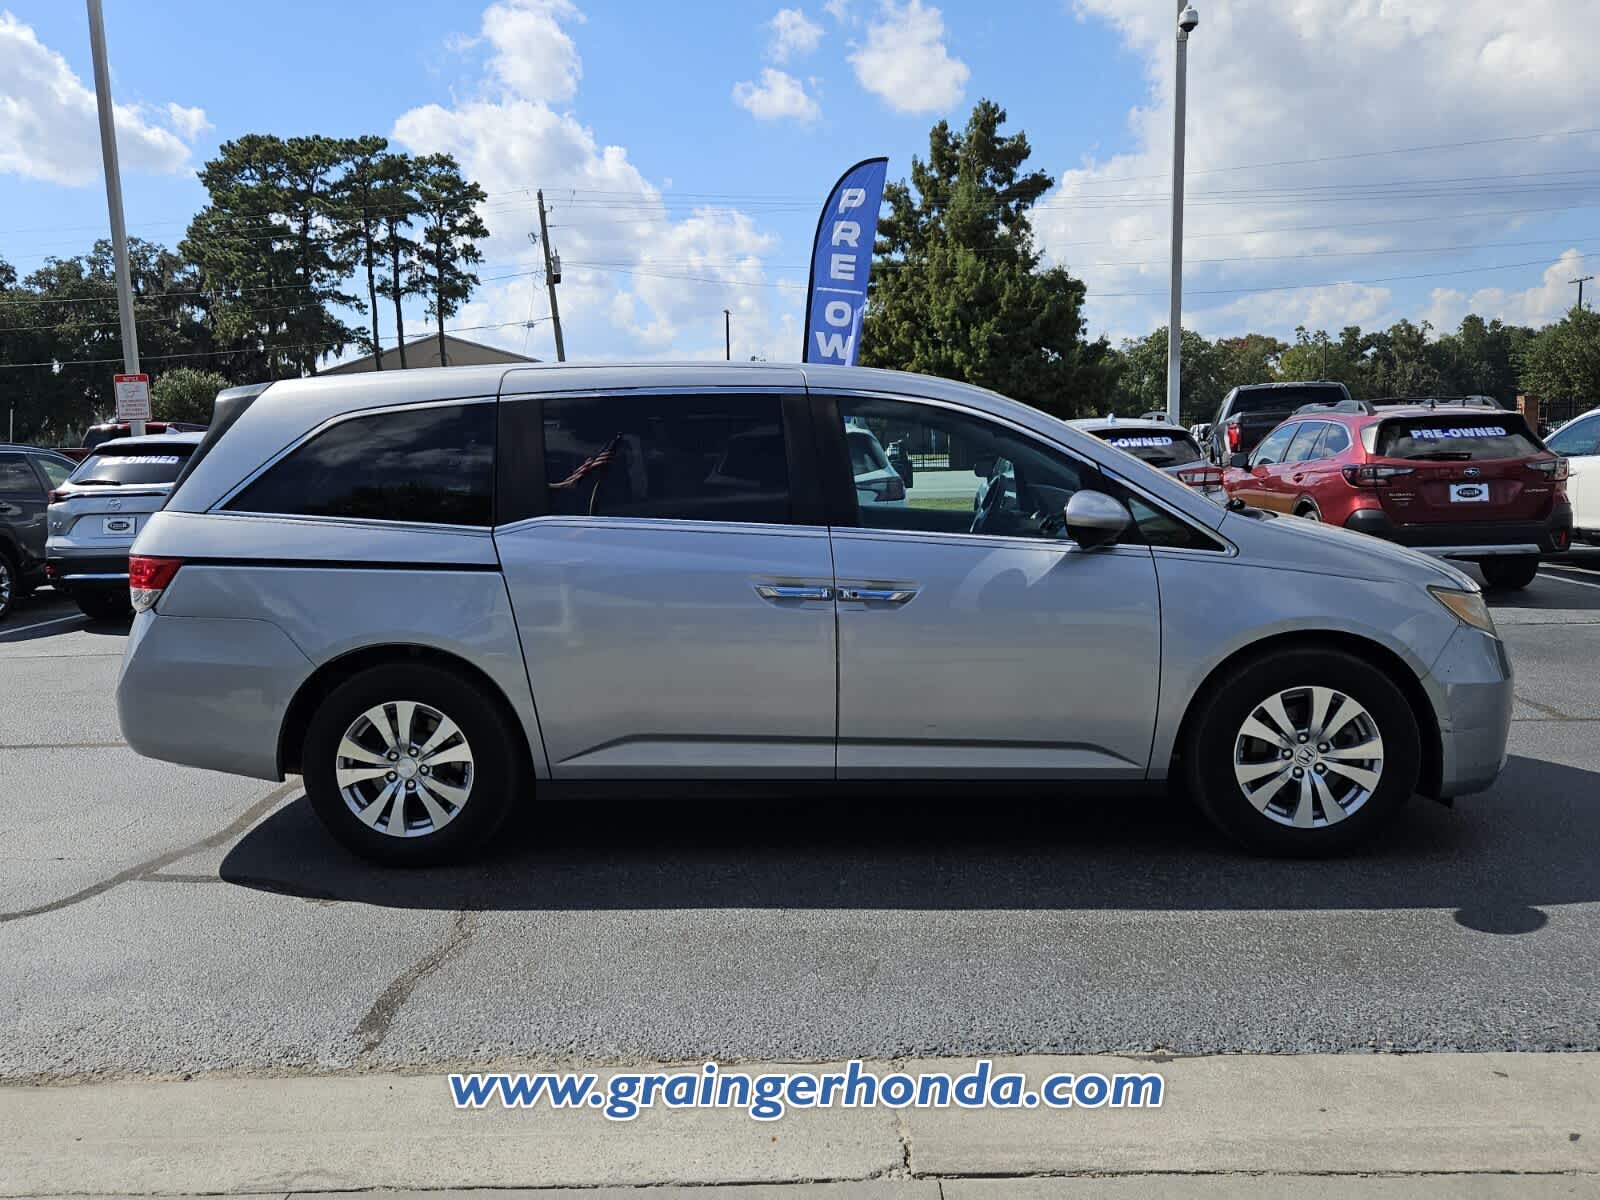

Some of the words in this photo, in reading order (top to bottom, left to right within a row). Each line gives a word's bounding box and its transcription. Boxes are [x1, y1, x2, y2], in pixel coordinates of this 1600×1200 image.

[830, 188, 866, 281] PRE
[815, 300, 853, 360] OW
[1410, 427, 1506, 439] PRE-OWNED
